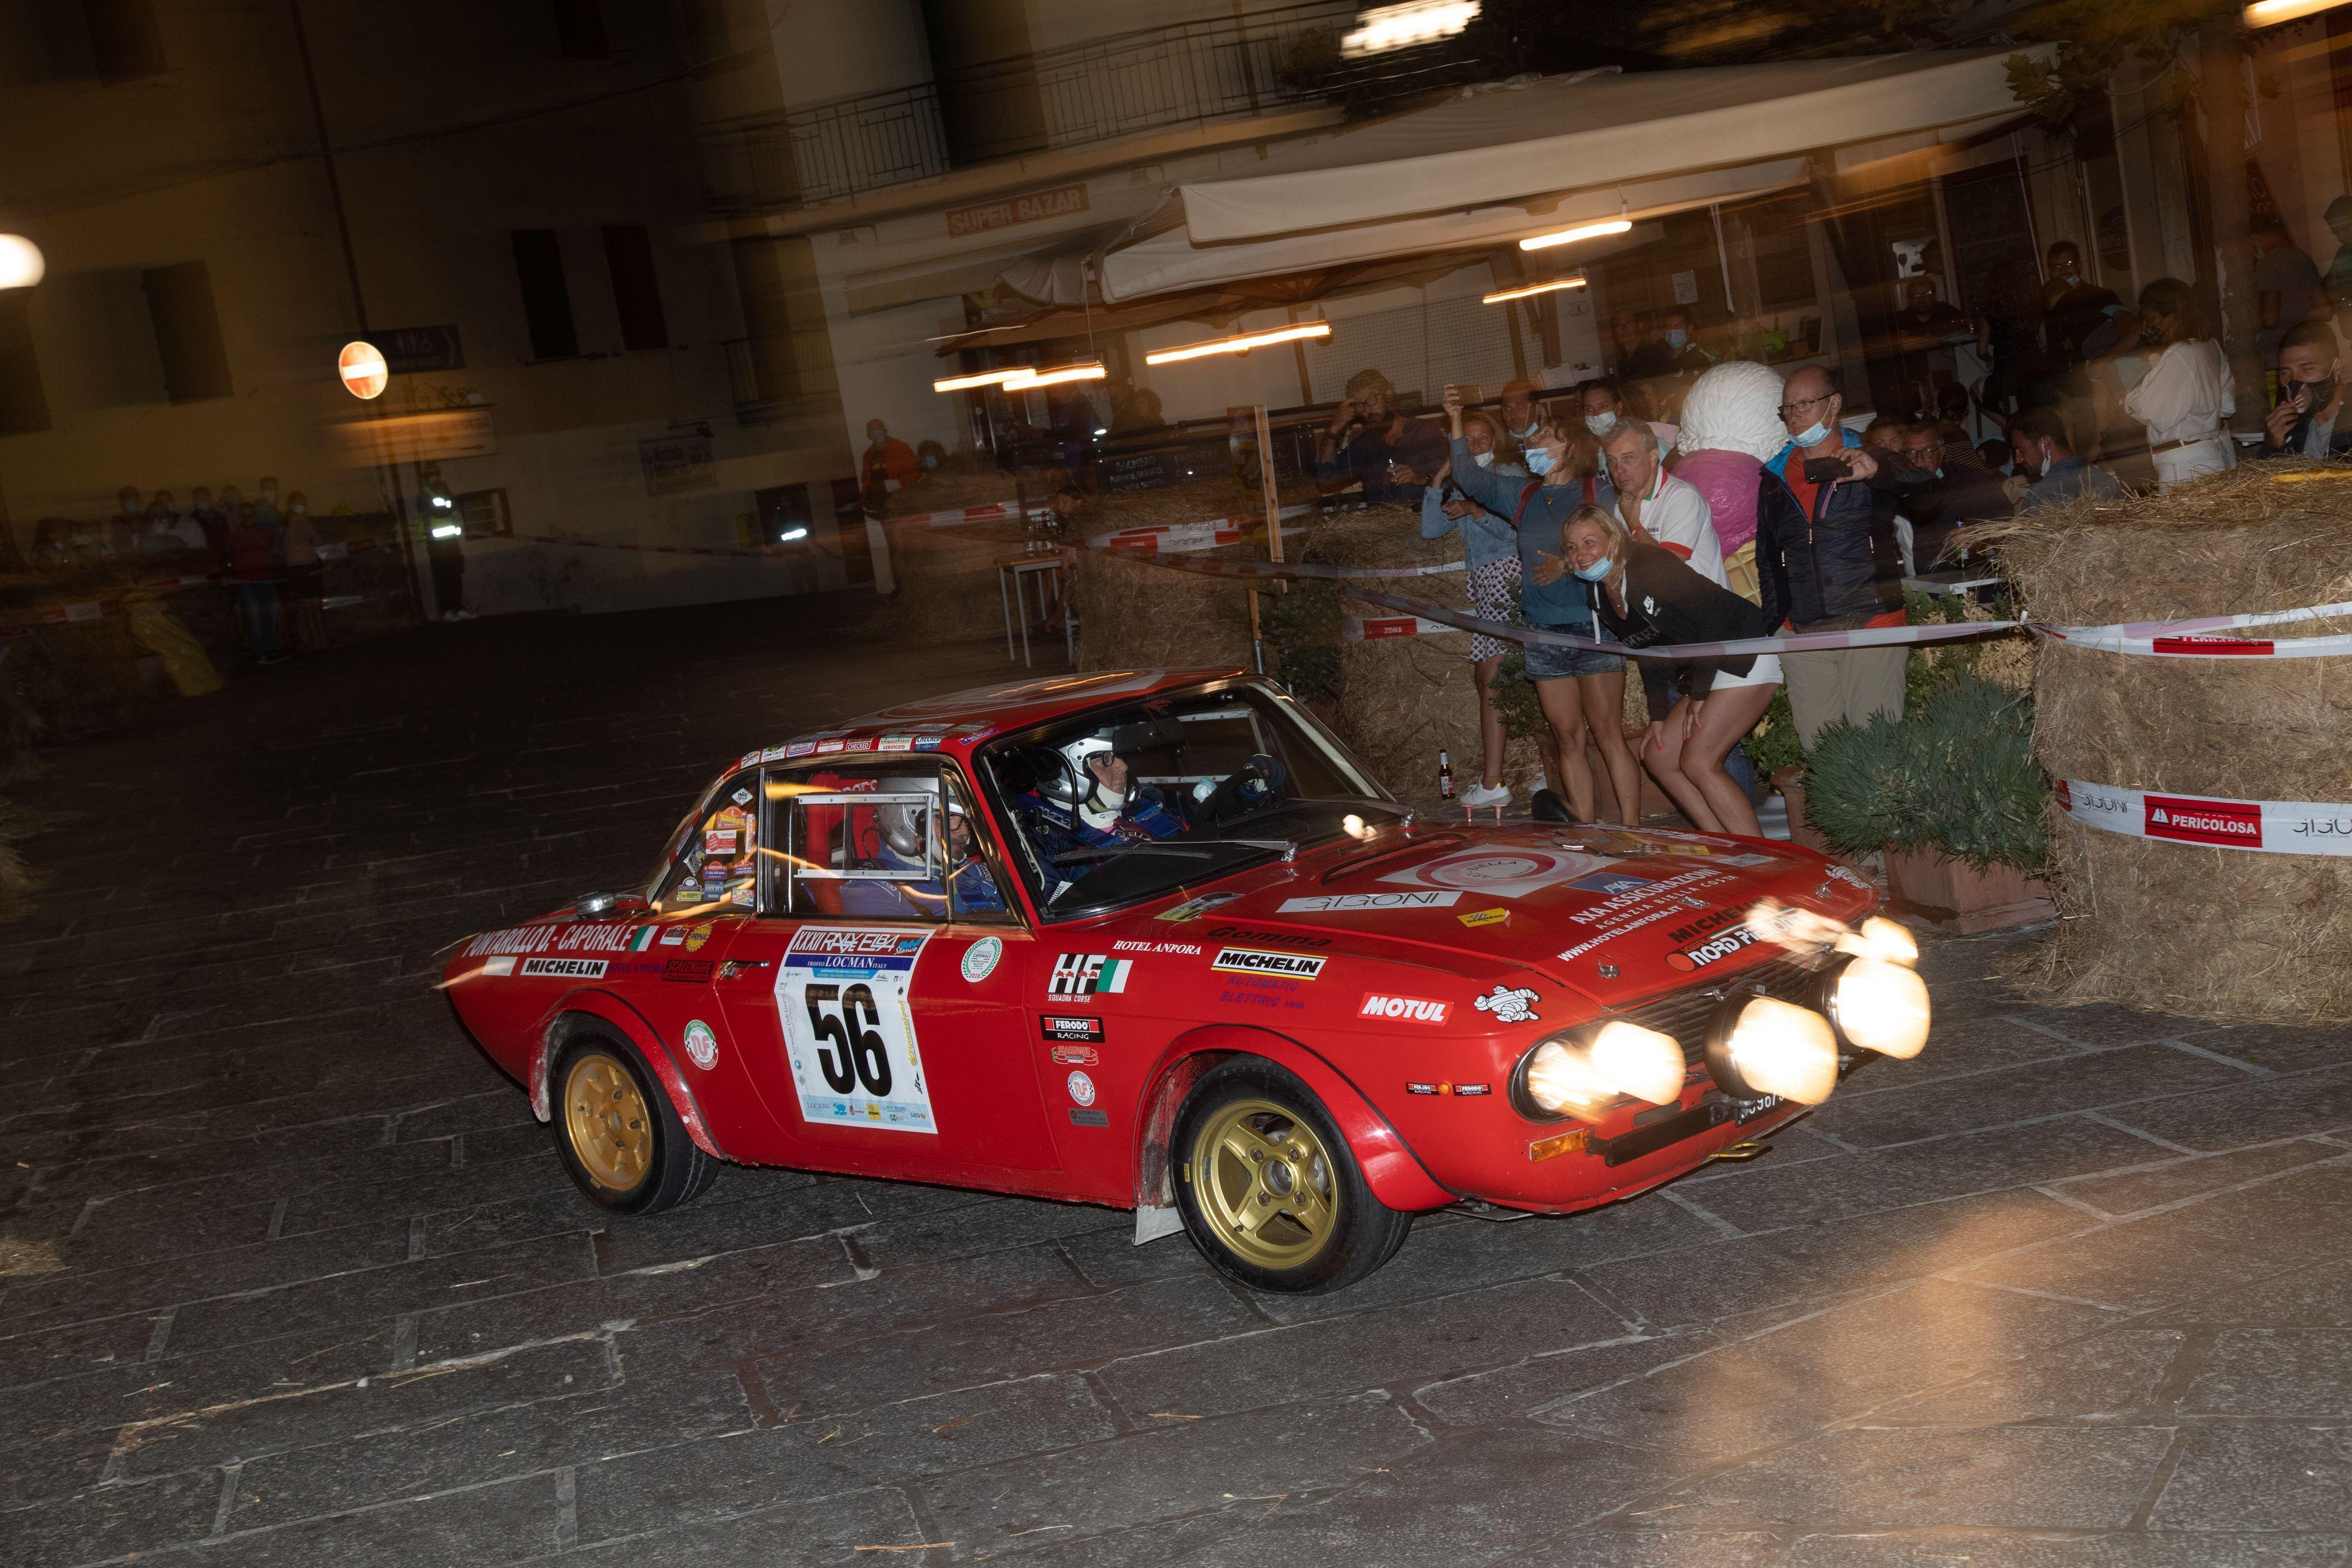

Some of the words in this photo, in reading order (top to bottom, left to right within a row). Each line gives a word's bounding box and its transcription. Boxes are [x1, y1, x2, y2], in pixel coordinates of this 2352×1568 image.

[950, 203, 1013, 235] SUPER
[1018, 189, 1081, 222] BAZAR
[1115, 456, 1155, 472] SGOMBRO
[720, 814, 744, 825] VERIFICATO
[2171, 814, 2257, 834] PERICOLOSA
[1466, 861, 1516, 871] BIELLA
[1602, 879, 1633, 894] AXA
[733, 891, 754, 902] VERIFICATO
[1304, 892, 1440, 911] GIGONI
[1569, 906, 1613, 925] AXA
[1608, 868, 1722, 910] ASSICURAZIONI
[1595, 903, 1653, 930] AGENZIA
[1655, 885, 1700, 905] BIELLA
[1701, 875, 1739, 888] COSTA
[1466, 914, 1505, 924] BARDAHL
[462, 926, 540, 958] PONTAROLLO
[559, 924, 639, 951] CAPORALE
[690, 932, 707, 942] PRINA
[791, 931, 826, 951] XXXII
[857, 934, 900, 951] ELBA
[1207, 926, 1334, 947] Gomma
[1557, 904, 1683, 962] WWW.HOTELANFORA.IT
[894, 945, 917, 955] Storico
[1112, 941, 1152, 951] HOTEL
[1152, 942, 1201, 955] ANFORA
[526, 959, 605, 975] MICHELIN
[667, 960, 711, 973] SCALENGHE
[825, 956, 876, 968] LOCMAN
[1218, 952, 1321, 974] MICHELIN
[1048, 954, 1107, 994] HF
[1227, 975, 1300, 991] AUTOMATIC
[781, 993, 790, 1012] Livorno
[1220, 991, 1280, 1007] ELETTRIC
[1361, 997, 1446, 1022] MOTUL
[1055, 1019, 1088, 1031] FERODO
[788, 1026, 797, 1055] Automobile
[805, 983, 893, 1097] 56
[1057, 1032, 1089, 1040] RACING
[1057, 1045, 1091, 1056] SCALENGHE
